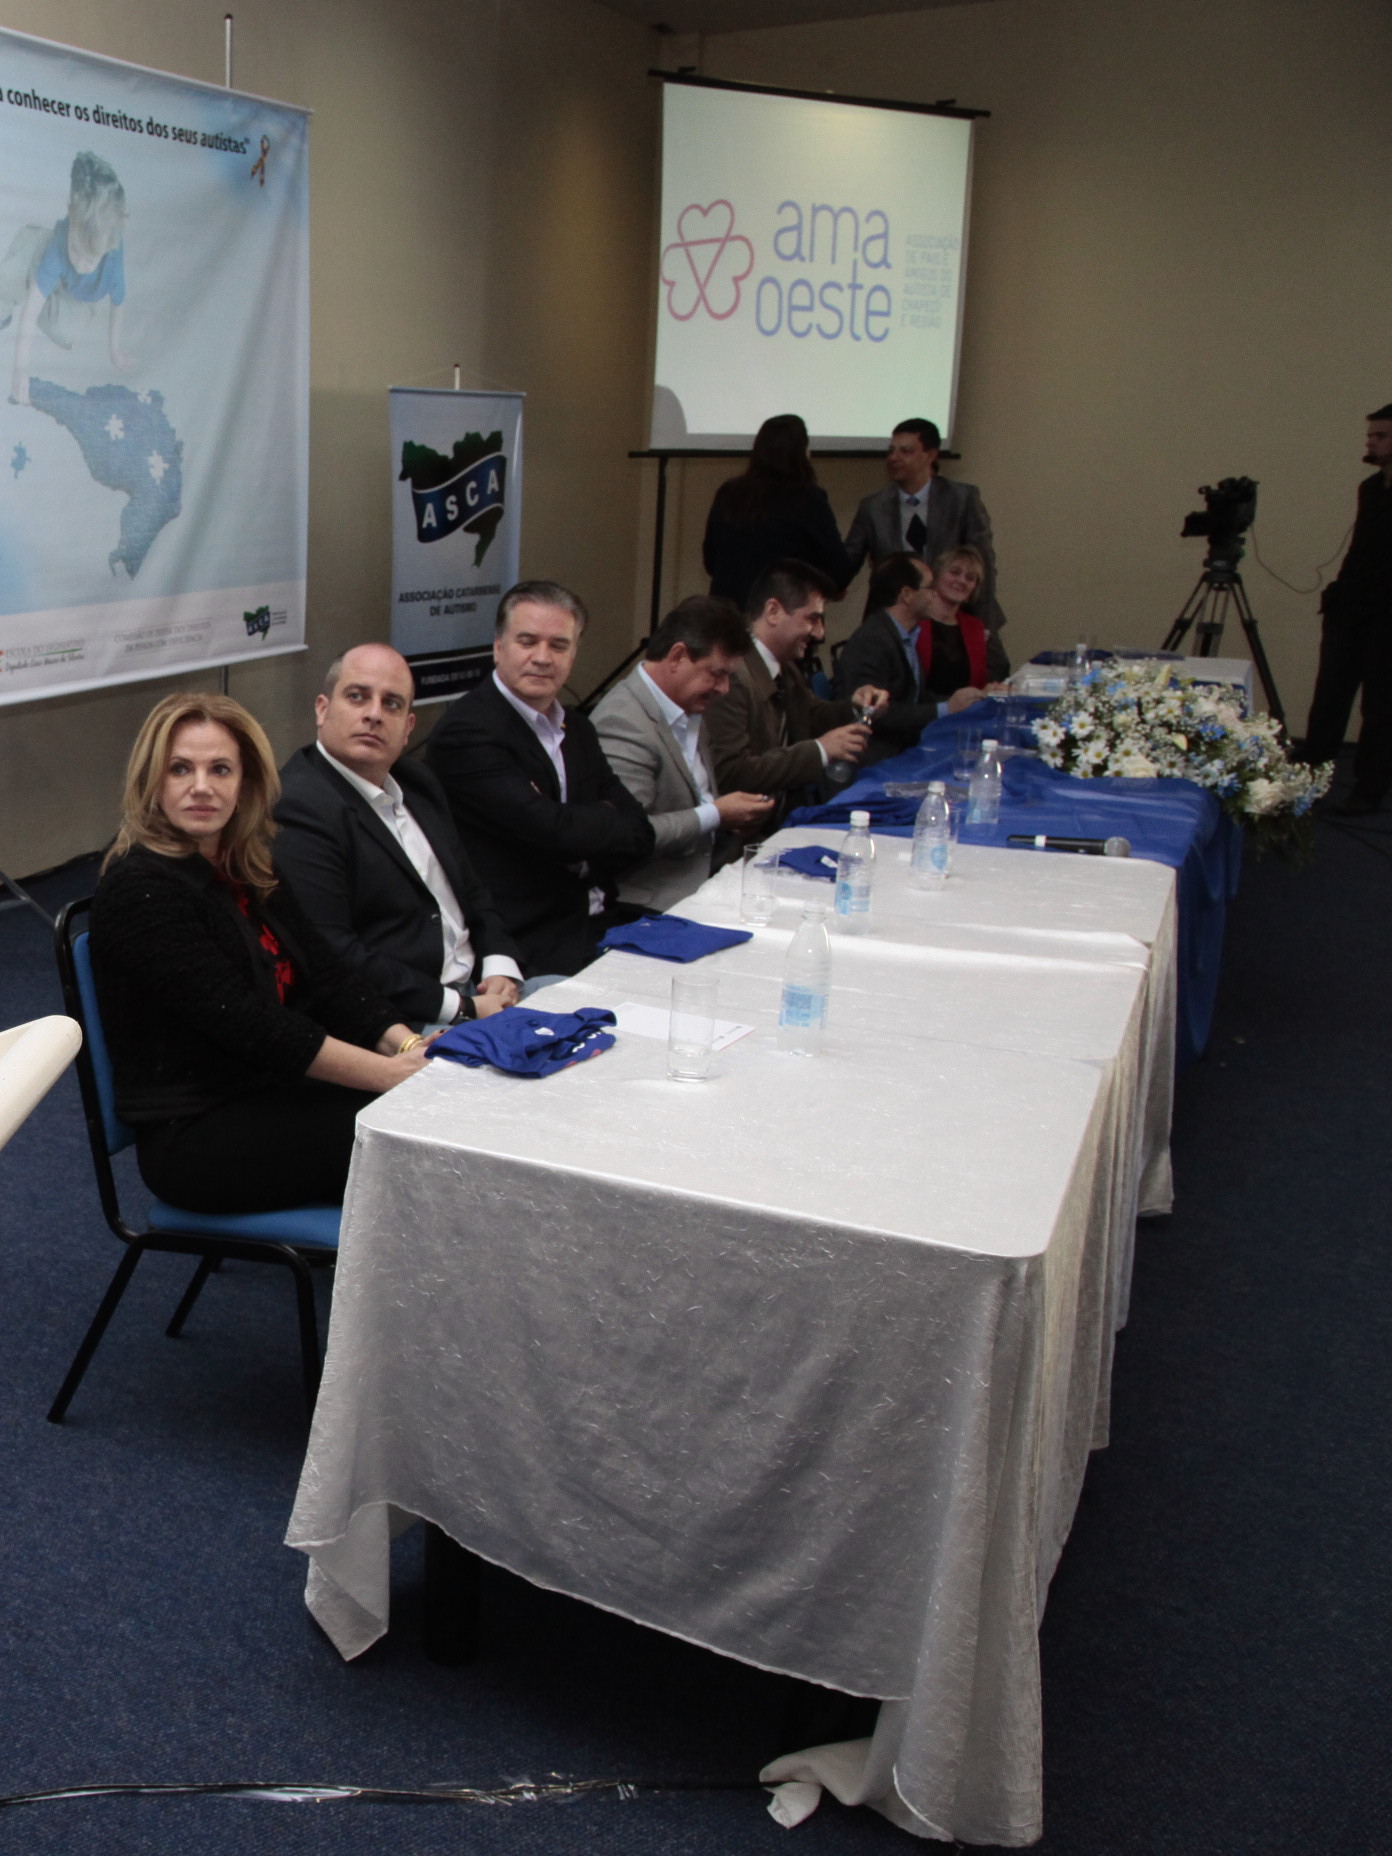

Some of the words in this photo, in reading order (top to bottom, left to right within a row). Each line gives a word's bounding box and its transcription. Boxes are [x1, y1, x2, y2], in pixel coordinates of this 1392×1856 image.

[7, 88, 71, 117] conhecer
[74, 104, 90, 122] os
[93, 104, 144, 134] direitos
[147, 116, 169, 139] dos
[171, 126, 198, 144] seus
[200, 131, 250, 155] autistas"
[773, 200, 892, 270] ama
[755, 257, 892, 342] oeste
[421, 469, 500, 529] ASCA
[398, 588, 454, 602] ASSOCIAÇÃO
[429, 605, 441, 617] DE
